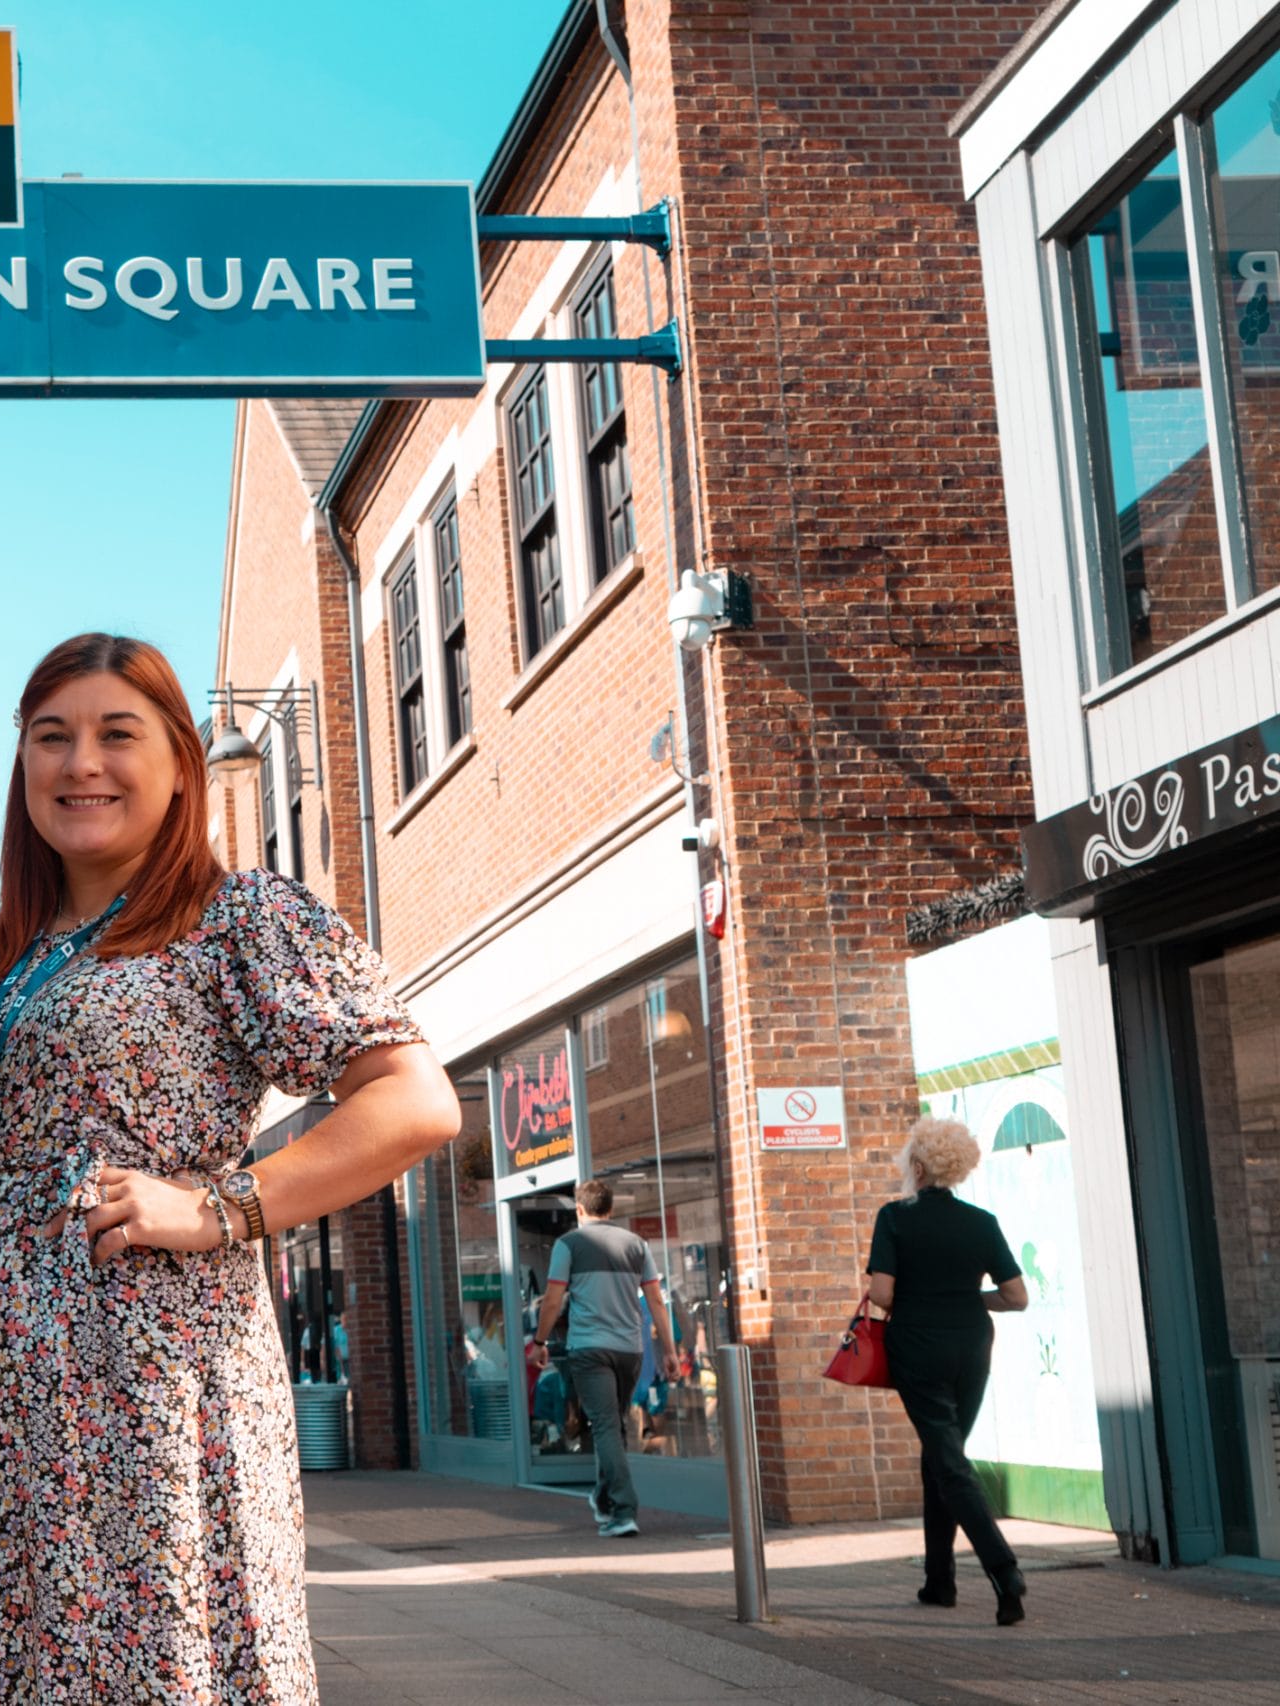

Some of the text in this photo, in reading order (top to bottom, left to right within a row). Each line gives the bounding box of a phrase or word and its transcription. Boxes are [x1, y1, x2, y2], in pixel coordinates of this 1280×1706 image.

[63, 255, 416, 321] SQUARE
[1199, 752, 1280, 821] Pas
[783, 1128, 821, 1136] CYCLISTS
